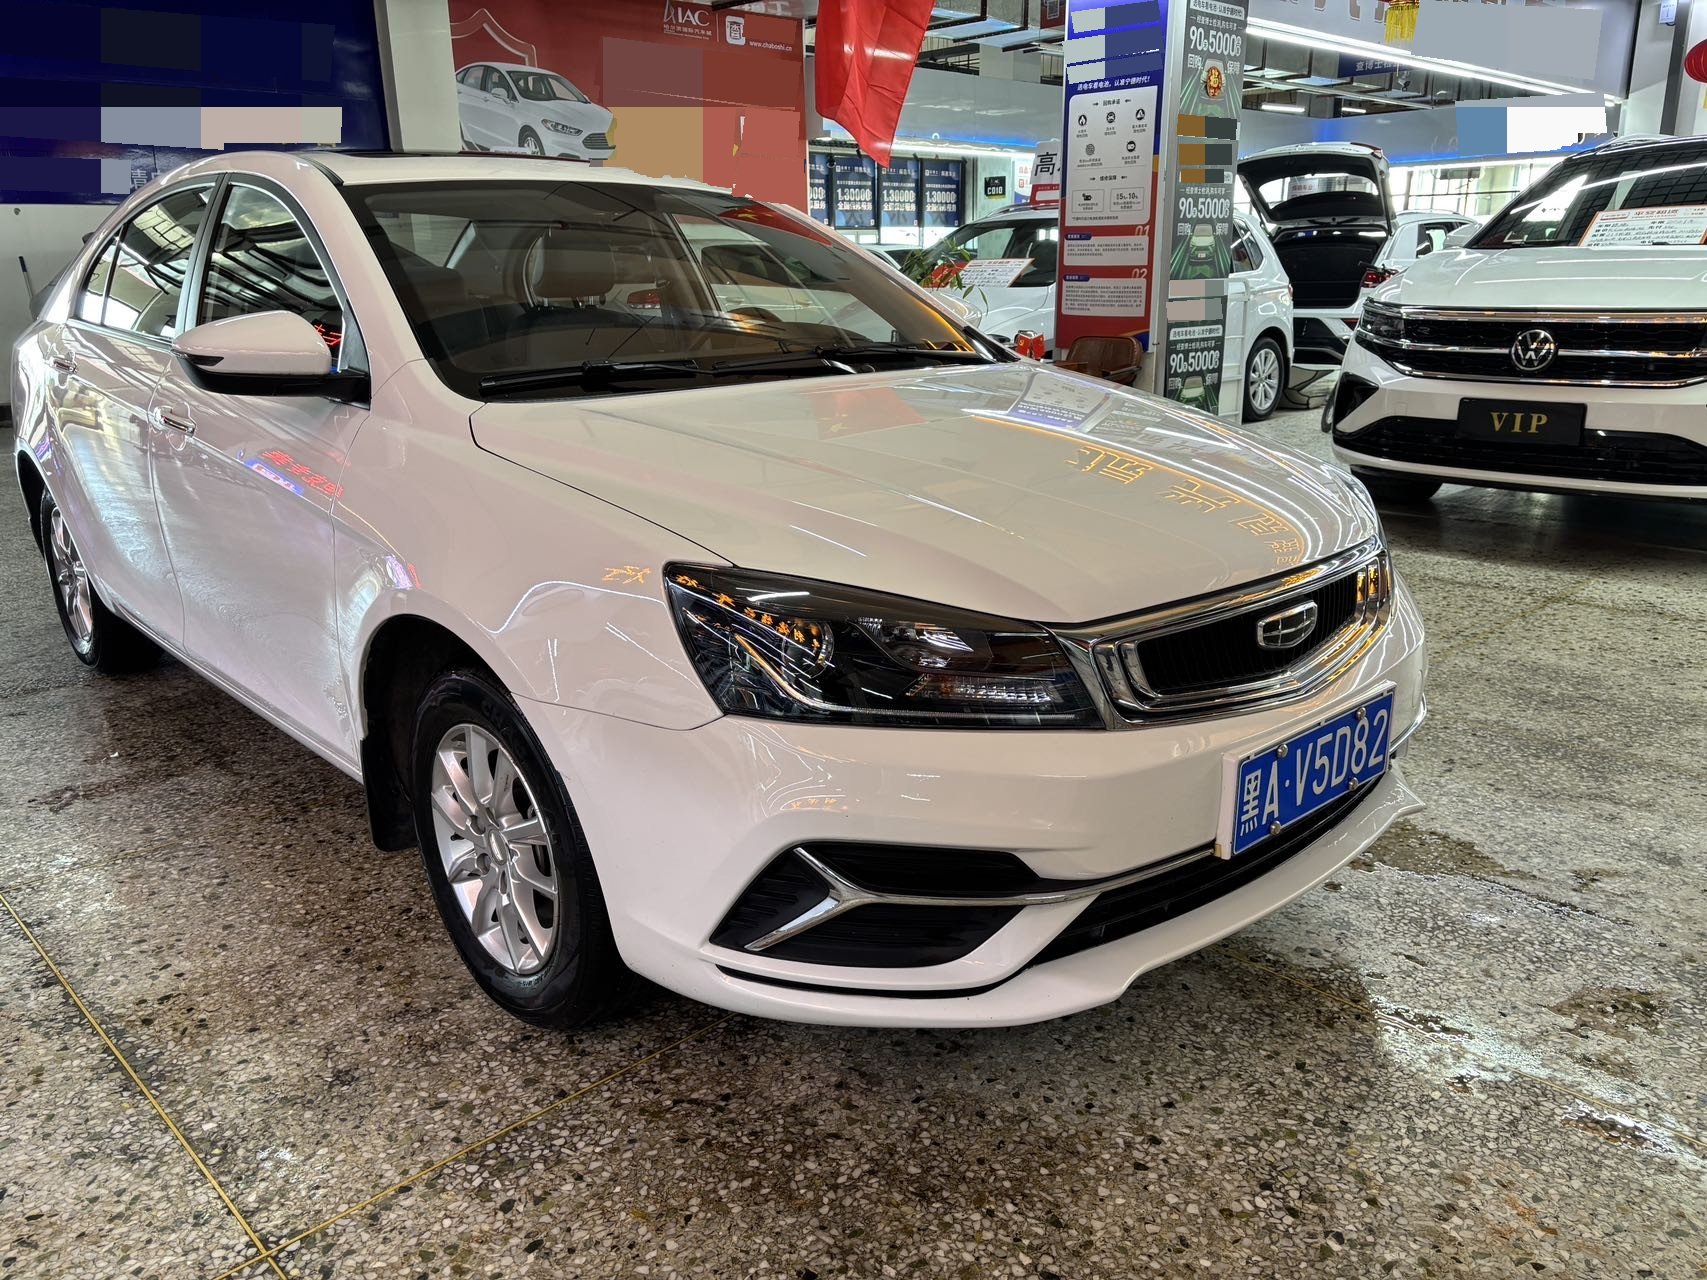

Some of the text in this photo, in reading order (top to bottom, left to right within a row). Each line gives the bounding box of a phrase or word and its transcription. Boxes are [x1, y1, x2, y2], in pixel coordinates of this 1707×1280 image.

[1135, 225, 1150, 236] 01
[1131, 268, 1148, 279] 02
[1490, 411, 1548, 433] VIP
